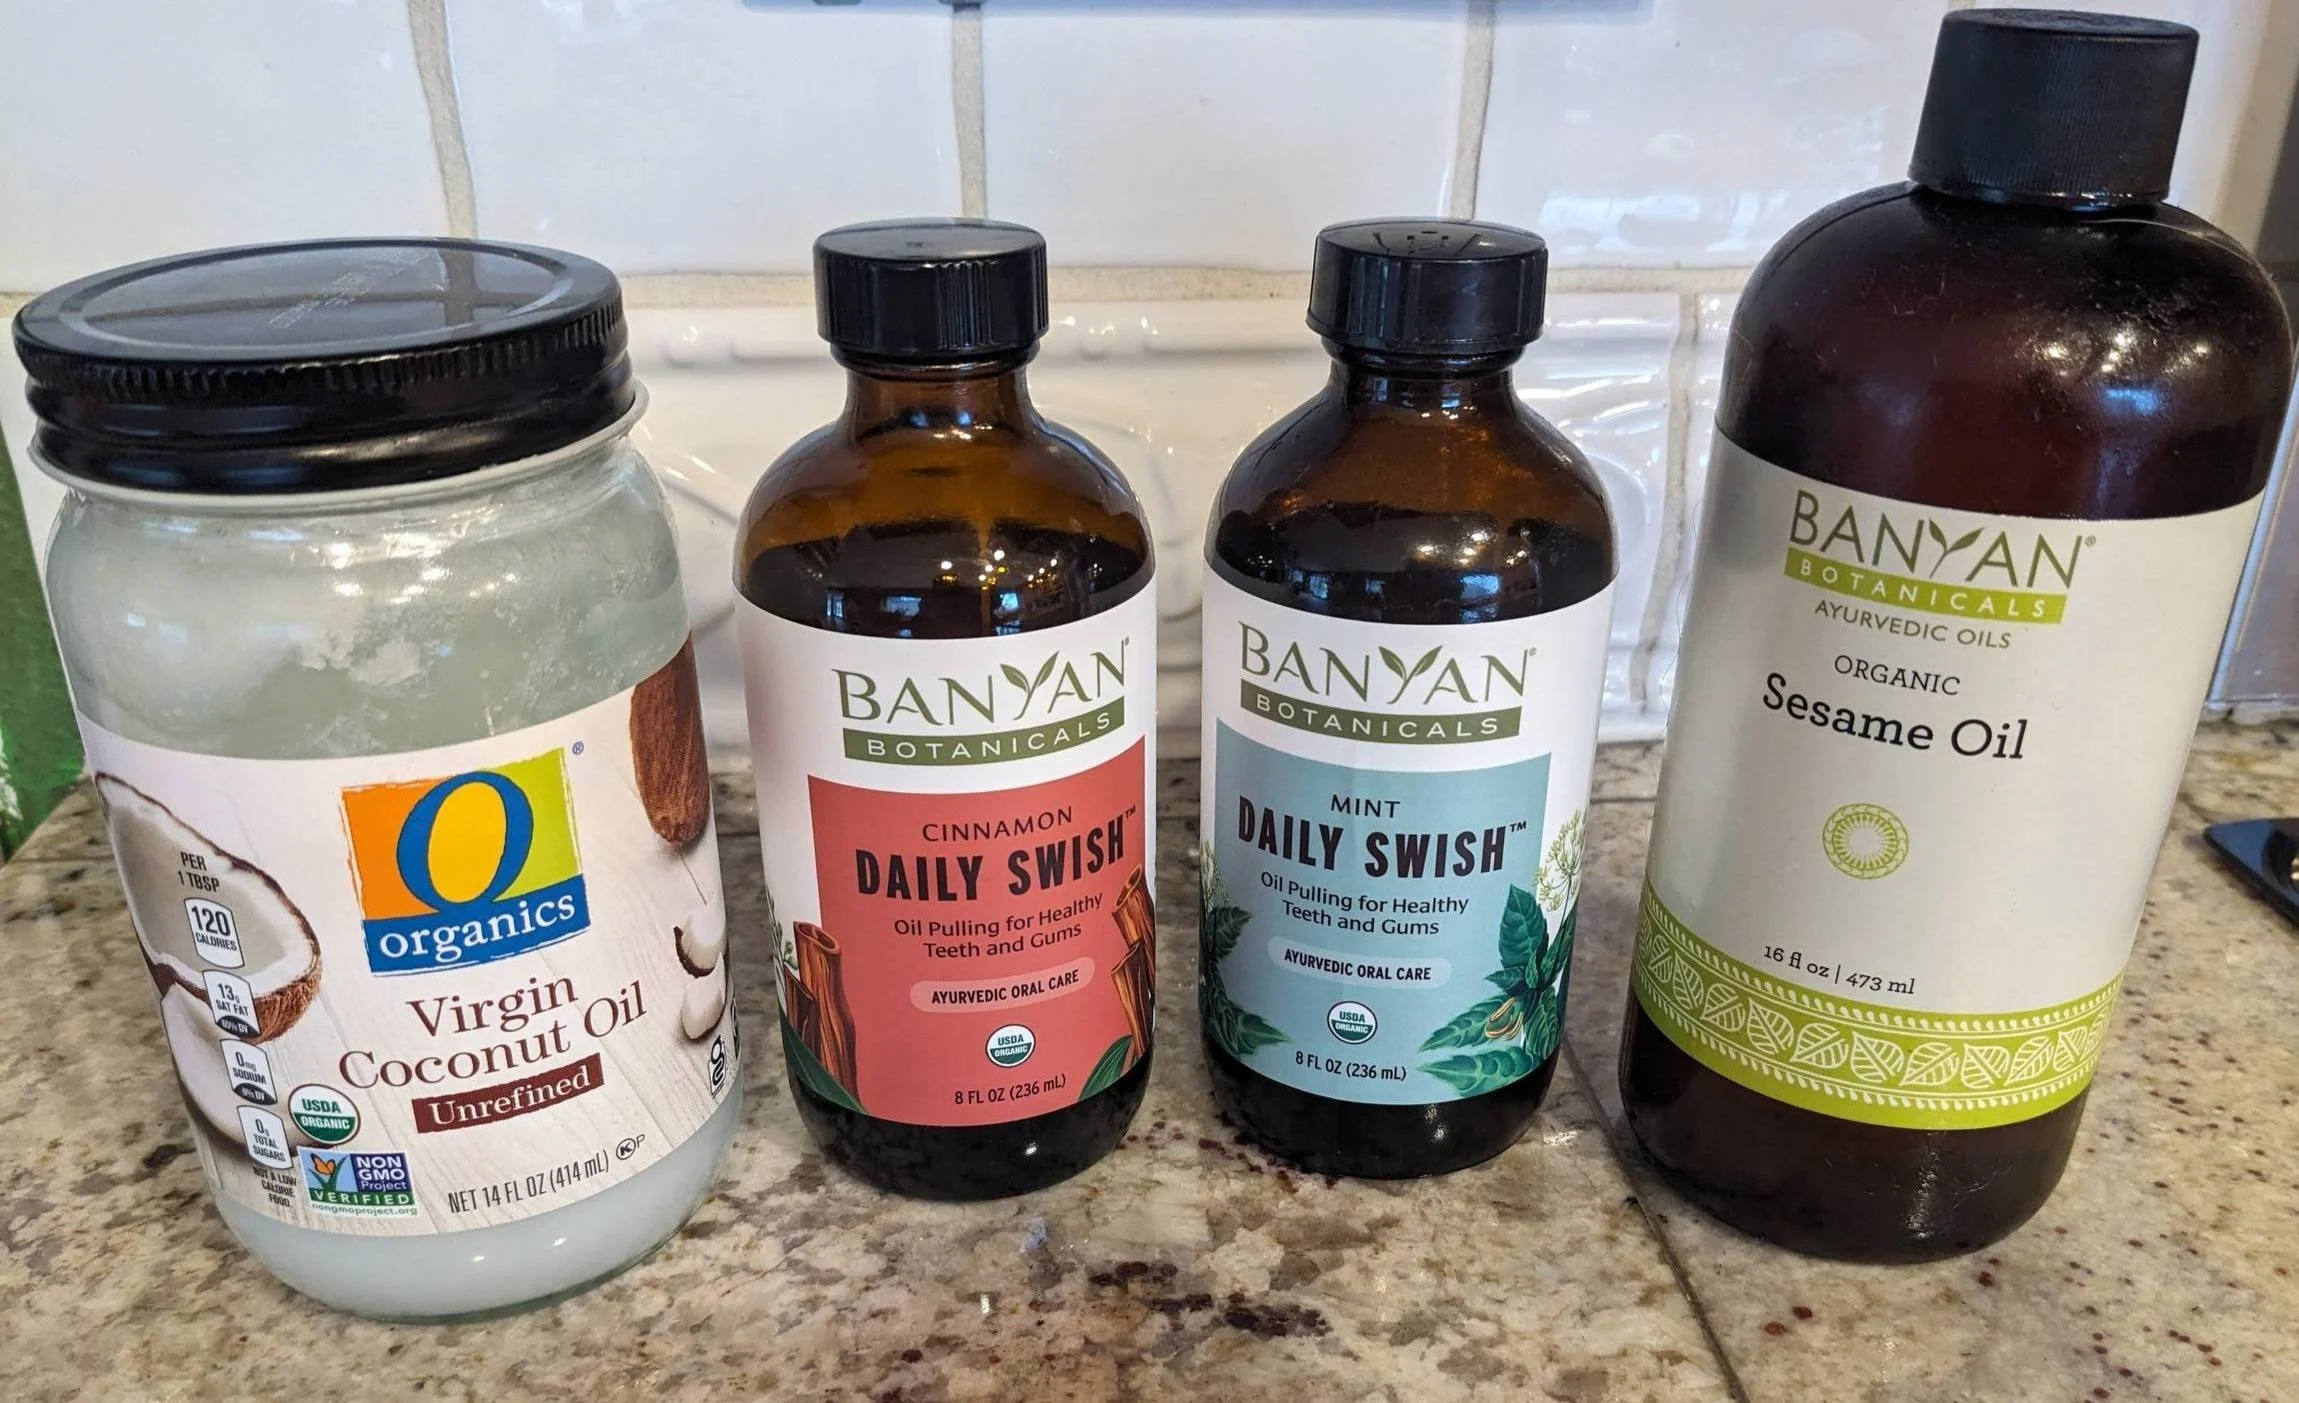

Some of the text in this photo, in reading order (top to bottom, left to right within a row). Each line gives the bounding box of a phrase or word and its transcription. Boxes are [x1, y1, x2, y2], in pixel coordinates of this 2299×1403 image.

[1800, 558, 2046, 618] BOTANICALS
[1814, 599, 2011, 650] AYURVEDIC OILS
[1833, 654, 1962, 696] ORGANIC
[1256, 693, 1499, 739] BOTANICALS
[1762, 672, 2028, 760] Sesame Oil
[867, 711, 1111, 760] BOTANICALS
[1330, 794, 1401, 819] MINT
[922, 805, 1073, 842] CINNAMON
[1238, 794, 1344, 871] DAILY
[396, 770, 534, 912] O
[180, 851, 207, 871] PER
[855, 848, 984, 902] DAILY
[177, 871, 220, 892] 1 TBSP
[1260, 871, 1470, 915] Oil Pulling for Healthy
[191, 905, 231, 937] 120
[379, 894, 576, 963] organics
[894, 892, 1104, 938] Oil Pulling for Healthy
[1281, 900, 1440, 936] Teeth and Gums
[195, 932, 238, 951] CALORIES
[922, 922, 1083, 958] Teeth and Gums
[1283, 947, 1432, 981] AYURVEDIC ORAL CARE
[1763, 945, 1785, 962] 16
[1788, 951, 1803, 970] fl
[1806, 962, 1830, 978] oz
[1845, 973, 1883, 992] 473
[1887, 978, 1915, 995] ml
[931, 968, 1080, 1005] AYURVEDIC ORAL CARE
[215, 999, 249, 1017] SAT FAT
[406, 976, 579, 1037] Virgin
[1339, 1010, 1366, 1024] USDA
[338, 979, 648, 1089] Coconut Oil
[997, 1033, 1024, 1046] USDA
[1335, 1022, 1369, 1034] ORGANIC
[994, 1045, 1028, 1057] ORGANIC
[1295, 1049, 1407, 1082] 8 FL OZ (236 mL)
[232, 1067, 267, 1085] SODIUM
[954, 1073, 1067, 1105] 8 FL OZ (236 mL)
[301, 1098, 343, 1114] USDA
[428, 1065, 591, 1125] Unrefined
[301, 1115, 350, 1130] ORGANIC
[252, 1133, 279, 1150] TOTAL
[252, 1145, 287, 1162] SUGARS
[356, 1156, 402, 1169] NON
[358, 1168, 406, 1182] GMO
[261, 1180, 296, 1198] CALORIE
[270, 1171, 278, 1182] A
[278, 1174, 297, 1187] LOW
[361, 1179, 408, 1192] Project
[447, 1149, 609, 1214] NET 14 FL OZ (414 mL)
[311, 1202, 418, 1217] nongmoproject.org
[314, 1189, 411, 1206] VERIFIED
